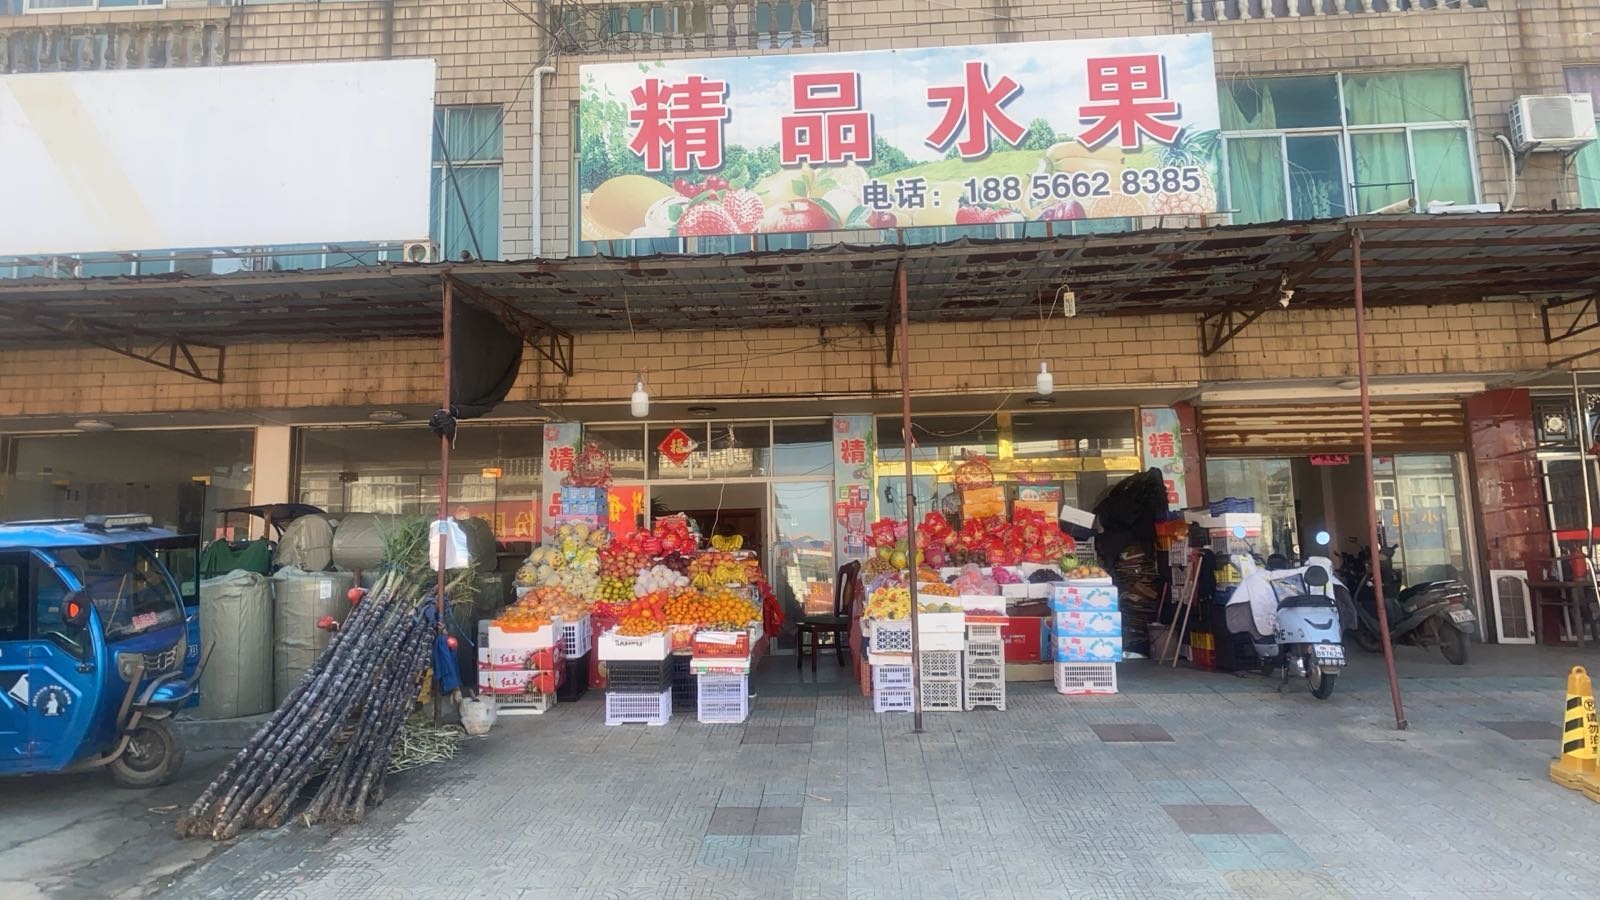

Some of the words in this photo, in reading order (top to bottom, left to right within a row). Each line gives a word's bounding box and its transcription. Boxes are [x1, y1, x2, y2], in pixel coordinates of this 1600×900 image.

[630, 55, 1183, 172] 精品水果
[964, 176, 1021, 203] 188
[1032, 172, 1110, 200] 5662
[1121, 167, 1200, 194] 8385
[840, 439, 866, 464] 精
